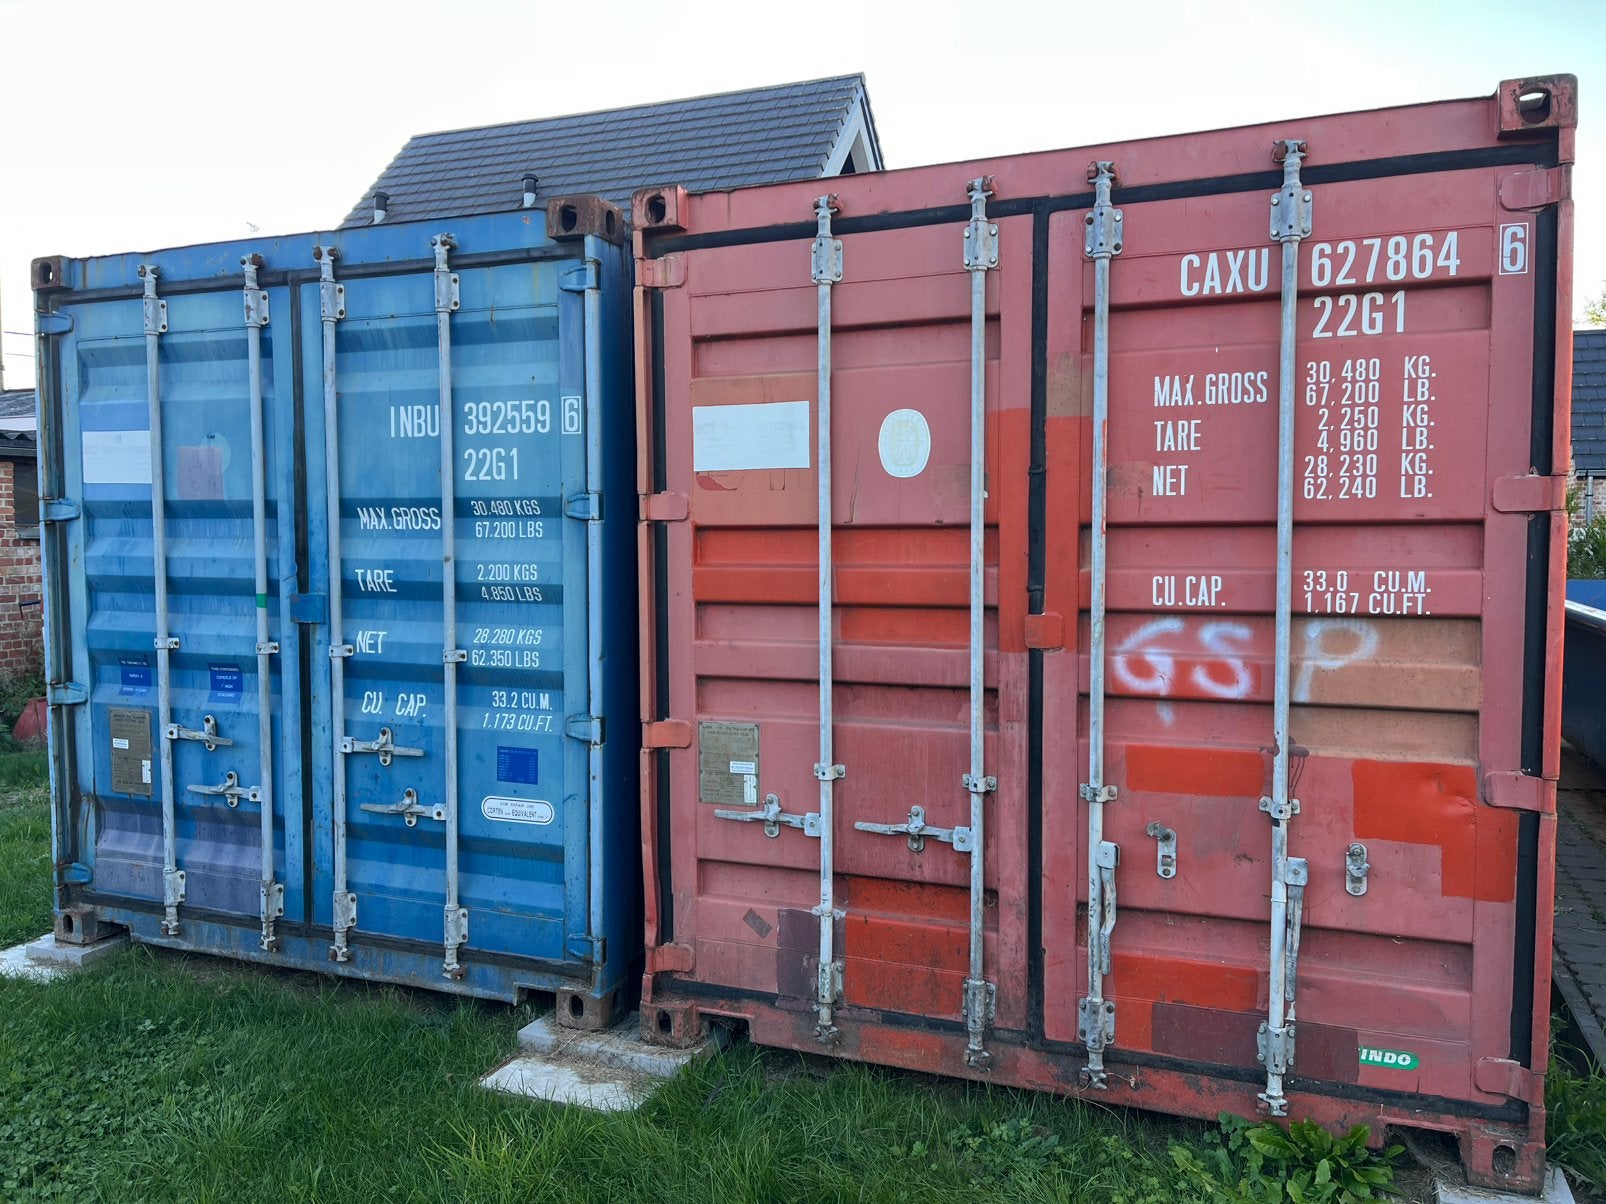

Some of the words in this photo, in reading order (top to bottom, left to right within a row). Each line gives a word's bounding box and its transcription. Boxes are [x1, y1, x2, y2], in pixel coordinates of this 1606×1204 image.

[1180, 248, 1269, 296] CAXU
[1311, 231, 1460, 287] 627864
[1503, 226, 1526, 272] 6
[1312, 290, 1406, 338] 22G1
[1154, 371, 1268, 407] MAX.GROSS
[1306, 358, 1380, 384] 30,480
[1404, 355, 1437, 379] KG.
[1306, 381, 1380, 406] 67,200
[1403, 379, 1436, 402] LB.
[390, 405, 440, 438] INBU
[463, 400, 551, 434] 392559
[564, 399, 579, 432] 6
[1318, 406, 1379, 431] 2,250
[1402, 404, 1435, 427] KG.
[1154, 420, 1202, 451] TARE
[1317, 429, 1378, 453] 4,960
[1401, 427, 1434, 450] LB.
[464, 447, 519, 481] 22G1
[1152, 465, 1188, 496] NET
[1304, 454, 1377, 478] 28,230
[1401, 452, 1433, 475] KG.
[1303, 476, 1377, 500] 62,240
[1400, 475, 1432, 498] LB.
[357, 507, 441, 530] MAX.GROSS
[514, 499, 541, 515] KGS
[519, 521, 543, 537] LBS
[355, 569, 397, 592] TARE
[513, 564, 538, 581] KGS
[1152, 575, 1226, 606] CU.CAP.
[1303, 570, 1348, 592] 33.0
[1373, 570, 1432, 593] CU.M.
[516, 586, 543, 602] LBS
[1368, 592, 1431, 615] CU.FT.
[356, 631, 387, 654] NET
[516, 629, 543, 645] KGS
[515, 651, 539, 668] LBS
[361, 691, 383, 714] CU.
[395, 693, 427, 718] CAP.
[492, 691, 519, 708] 33.2
[521, 692, 553, 710] CU.M.
[517, 714, 553, 732] CU.FT.
[1358, 1048, 1411, 1066] INDO
